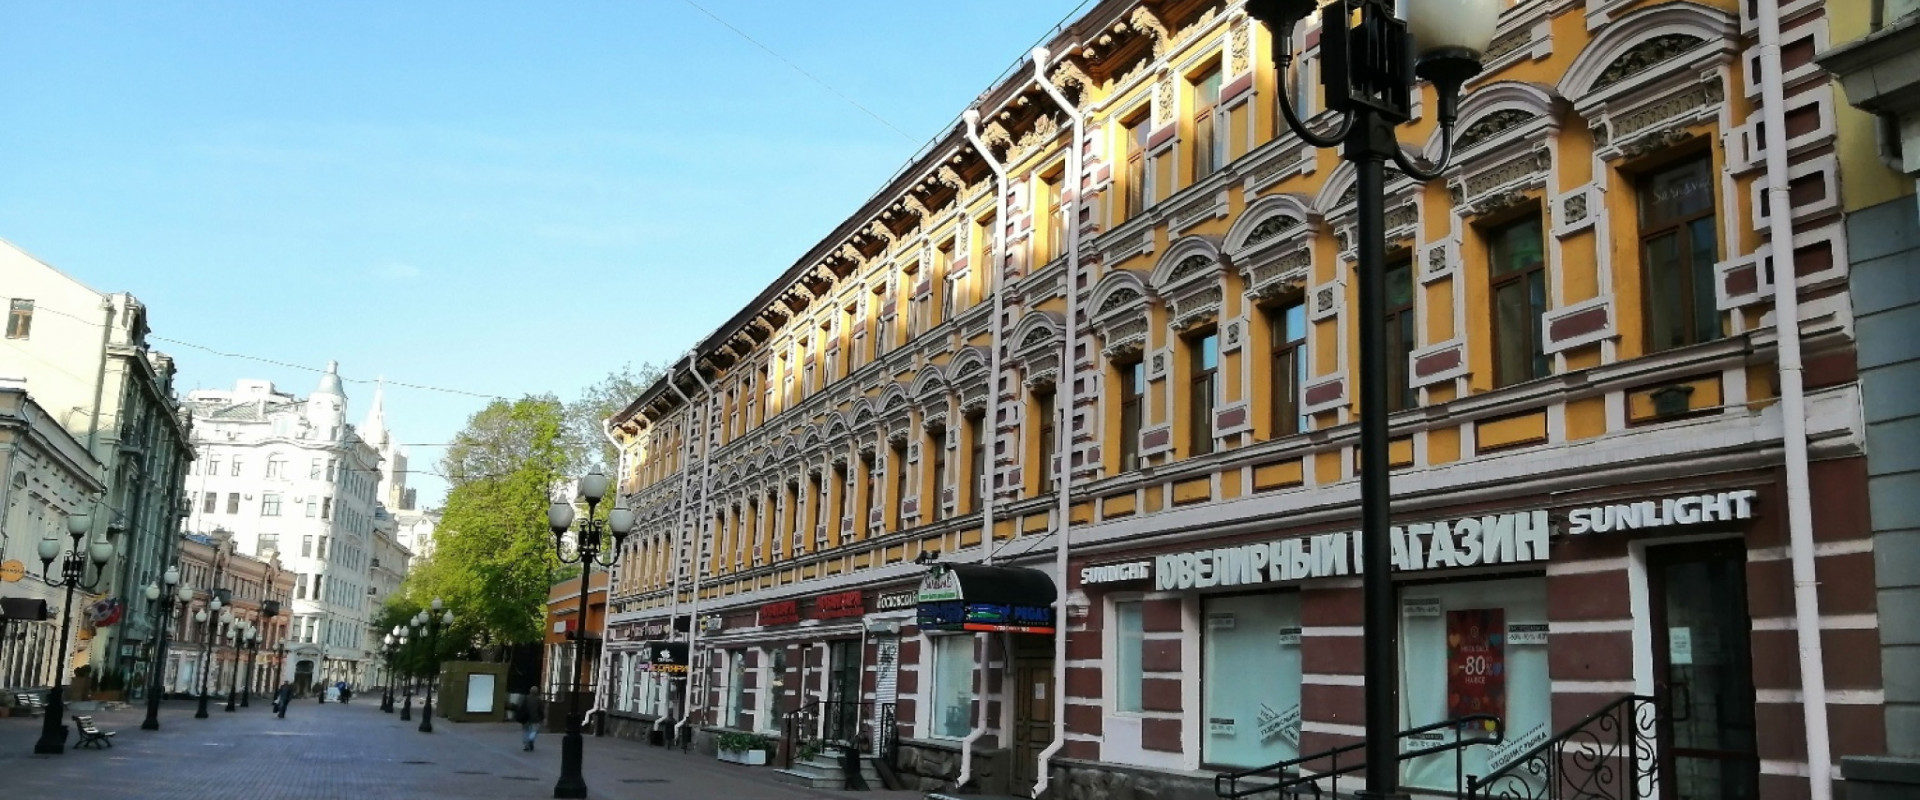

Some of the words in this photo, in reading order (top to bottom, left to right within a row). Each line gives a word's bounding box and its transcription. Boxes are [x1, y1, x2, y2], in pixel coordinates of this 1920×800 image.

[1568, 489, 1757, 535] SUNLIGHT
[1080, 561, 1151, 584] SUNLIGHT
[1155, 532, 1348, 591] ЮВЕЛИРНЫЙ
